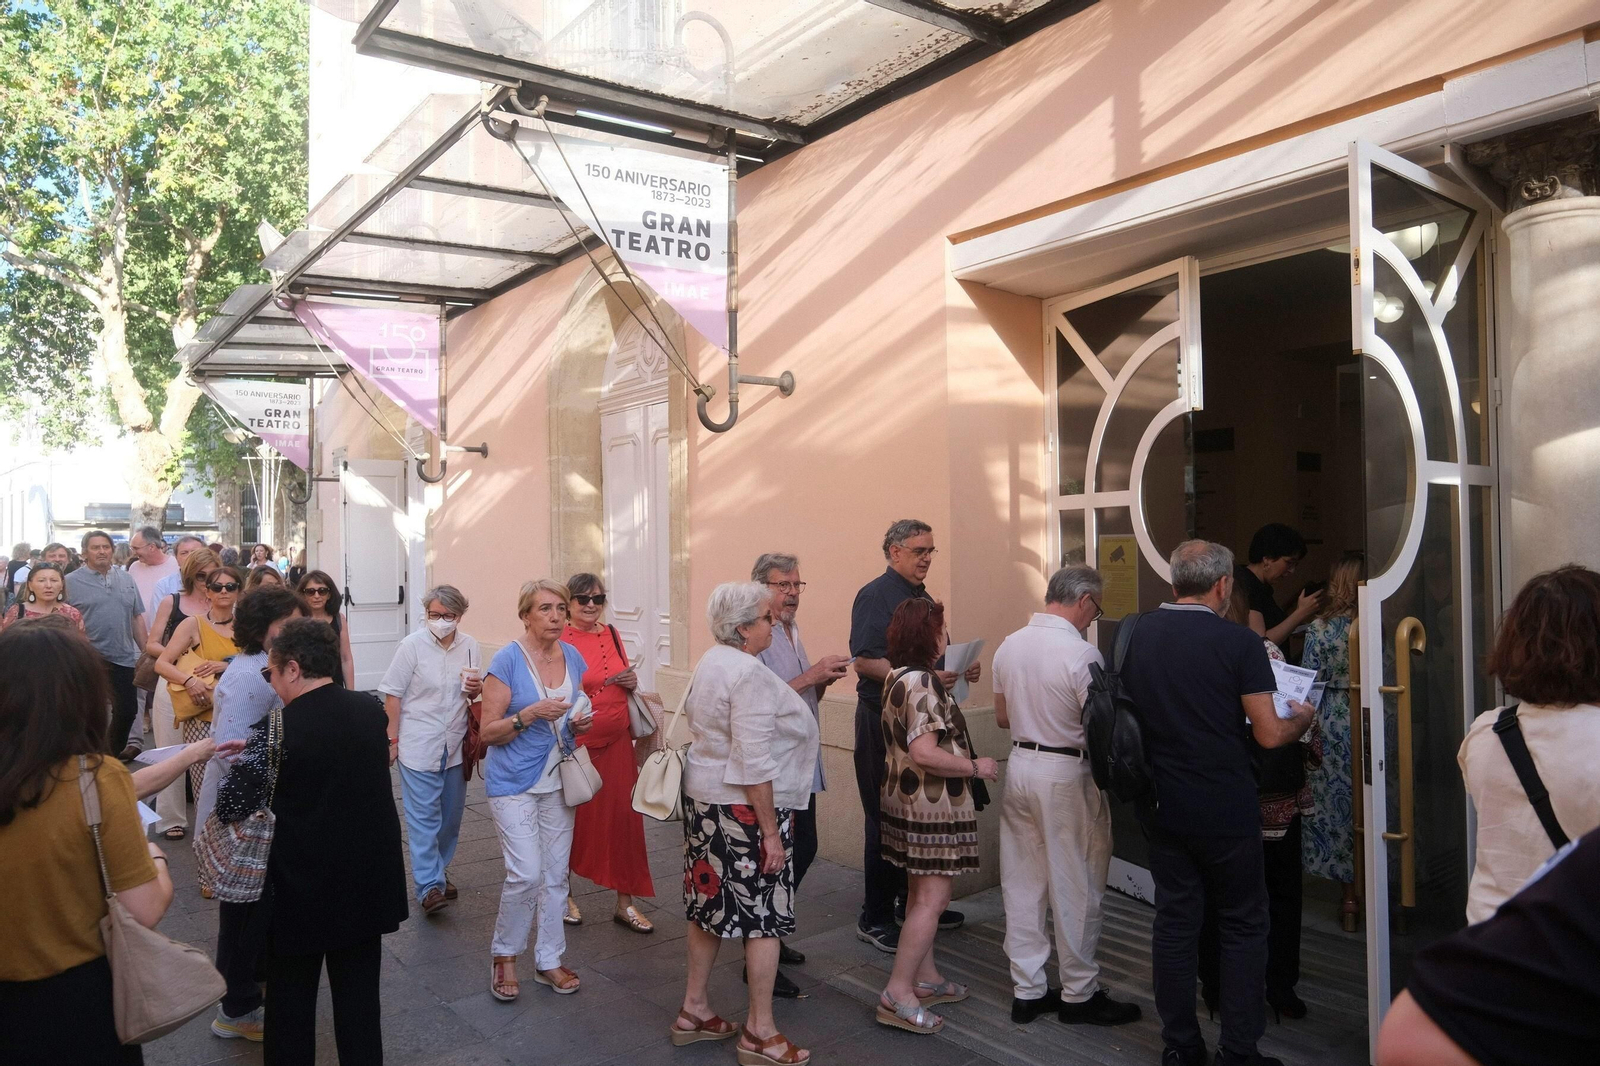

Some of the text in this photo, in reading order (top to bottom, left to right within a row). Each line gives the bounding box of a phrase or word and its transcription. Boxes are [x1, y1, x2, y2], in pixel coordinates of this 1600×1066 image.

[585, 163, 711, 197] 150 ANIVERSARIO
[642, 210, 711, 238] GRAN
[611, 229, 711, 261] TEATRO
[664, 281, 710, 300] IMAE
[235, 389, 301, 401] 150 ANIVERSARIO
[264, 408, 301, 418] GRAN
[248, 418, 301, 430] TEATRO
[275, 439, 300, 448] IMAE
